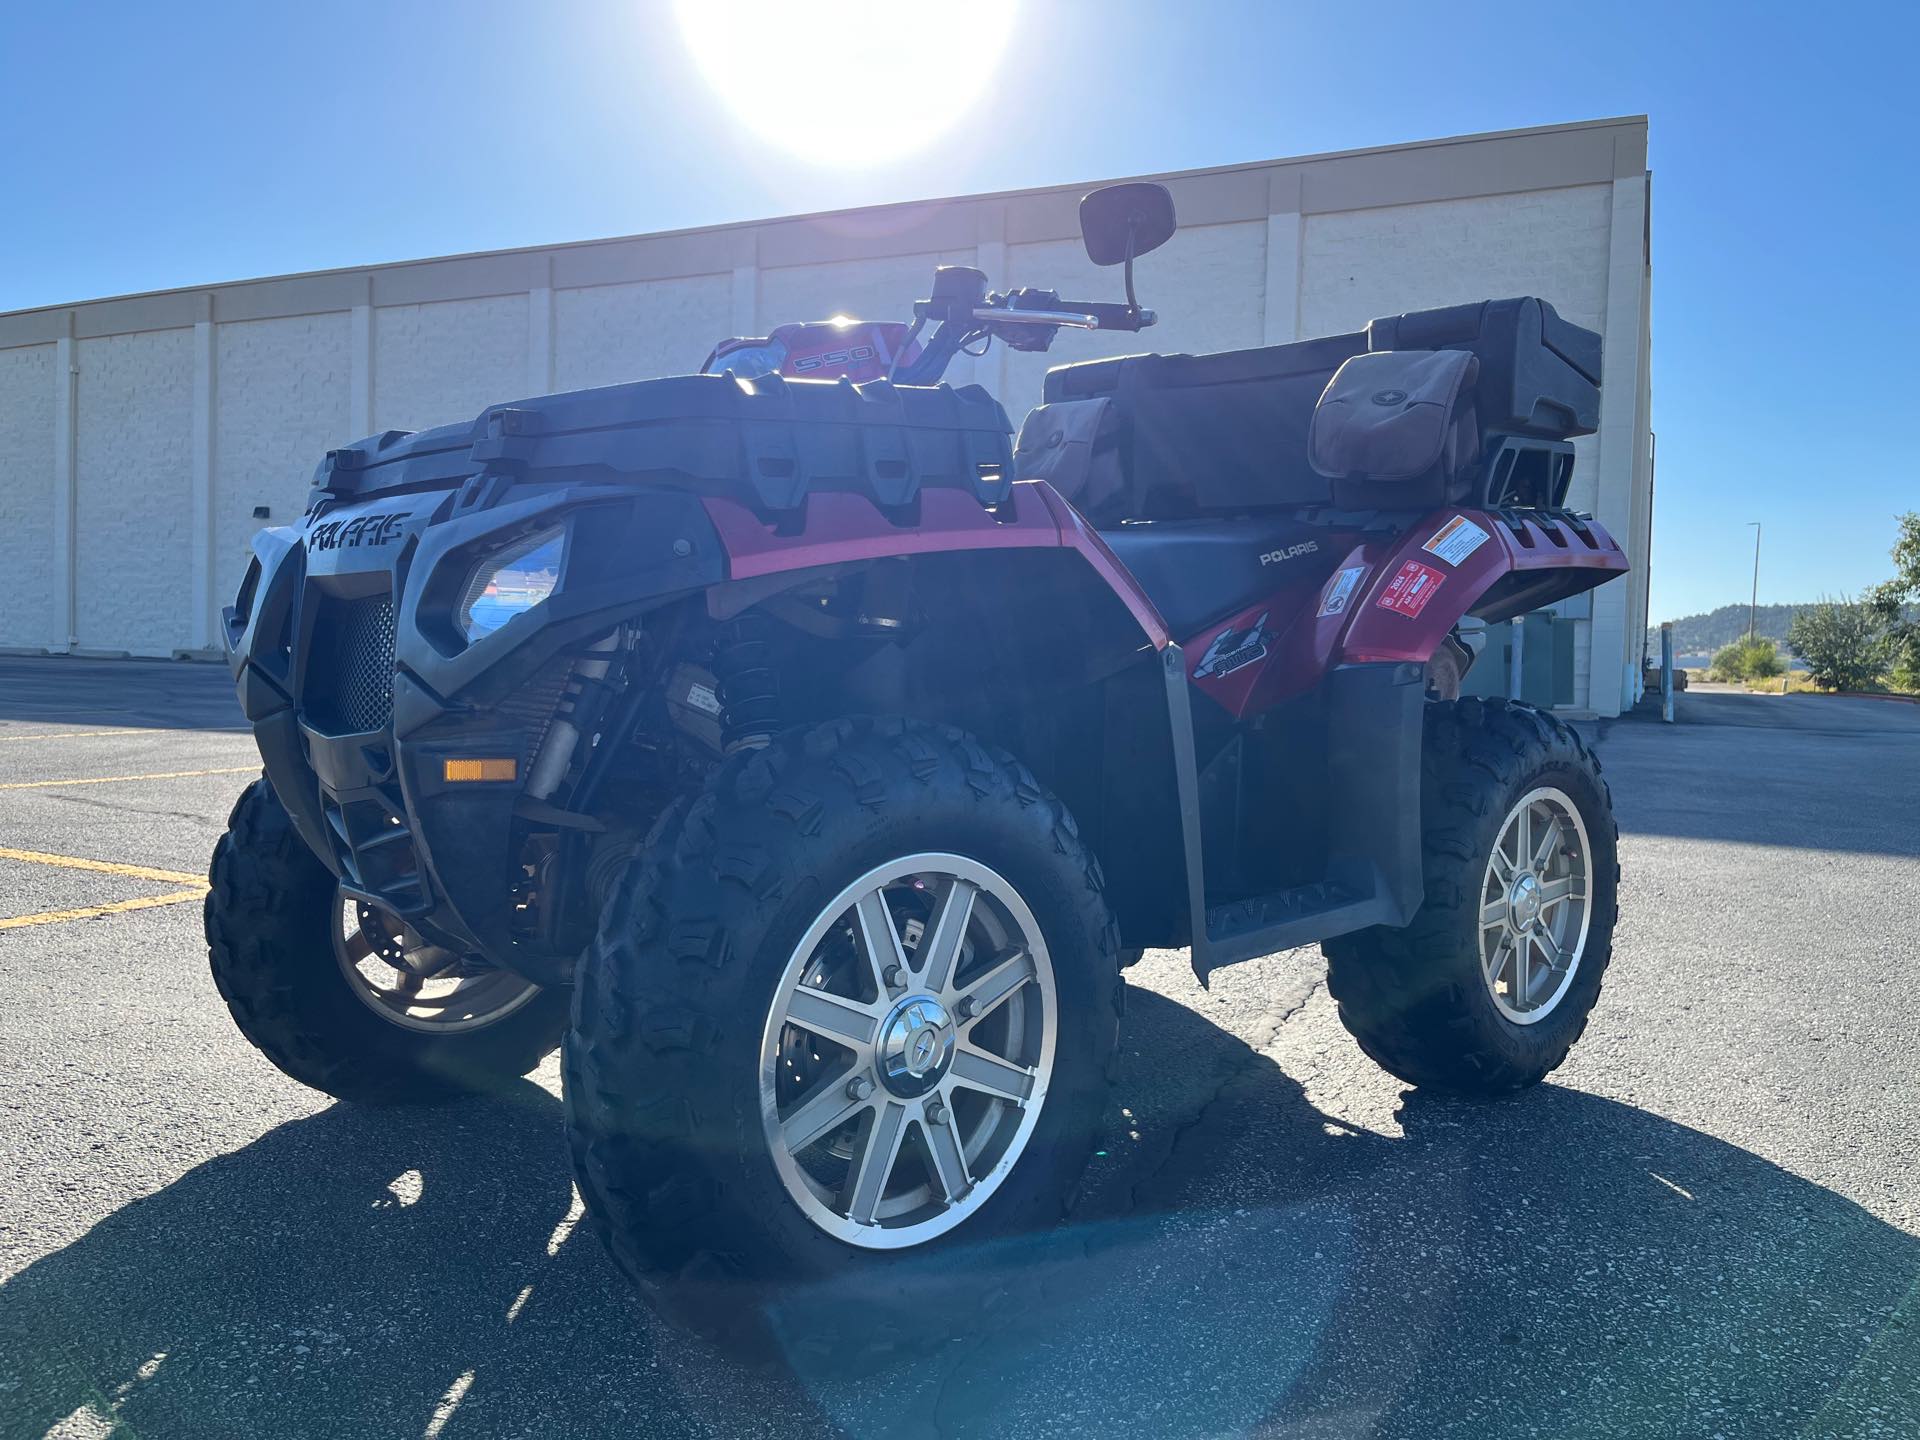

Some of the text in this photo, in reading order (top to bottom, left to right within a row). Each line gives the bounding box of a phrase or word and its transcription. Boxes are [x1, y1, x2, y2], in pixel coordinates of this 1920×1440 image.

[793, 345, 873, 373] 550
[308, 512, 413, 553] POLARIS
[1259, 540, 1318, 566] POLARIS
[1391, 575, 1404, 591] 2024
